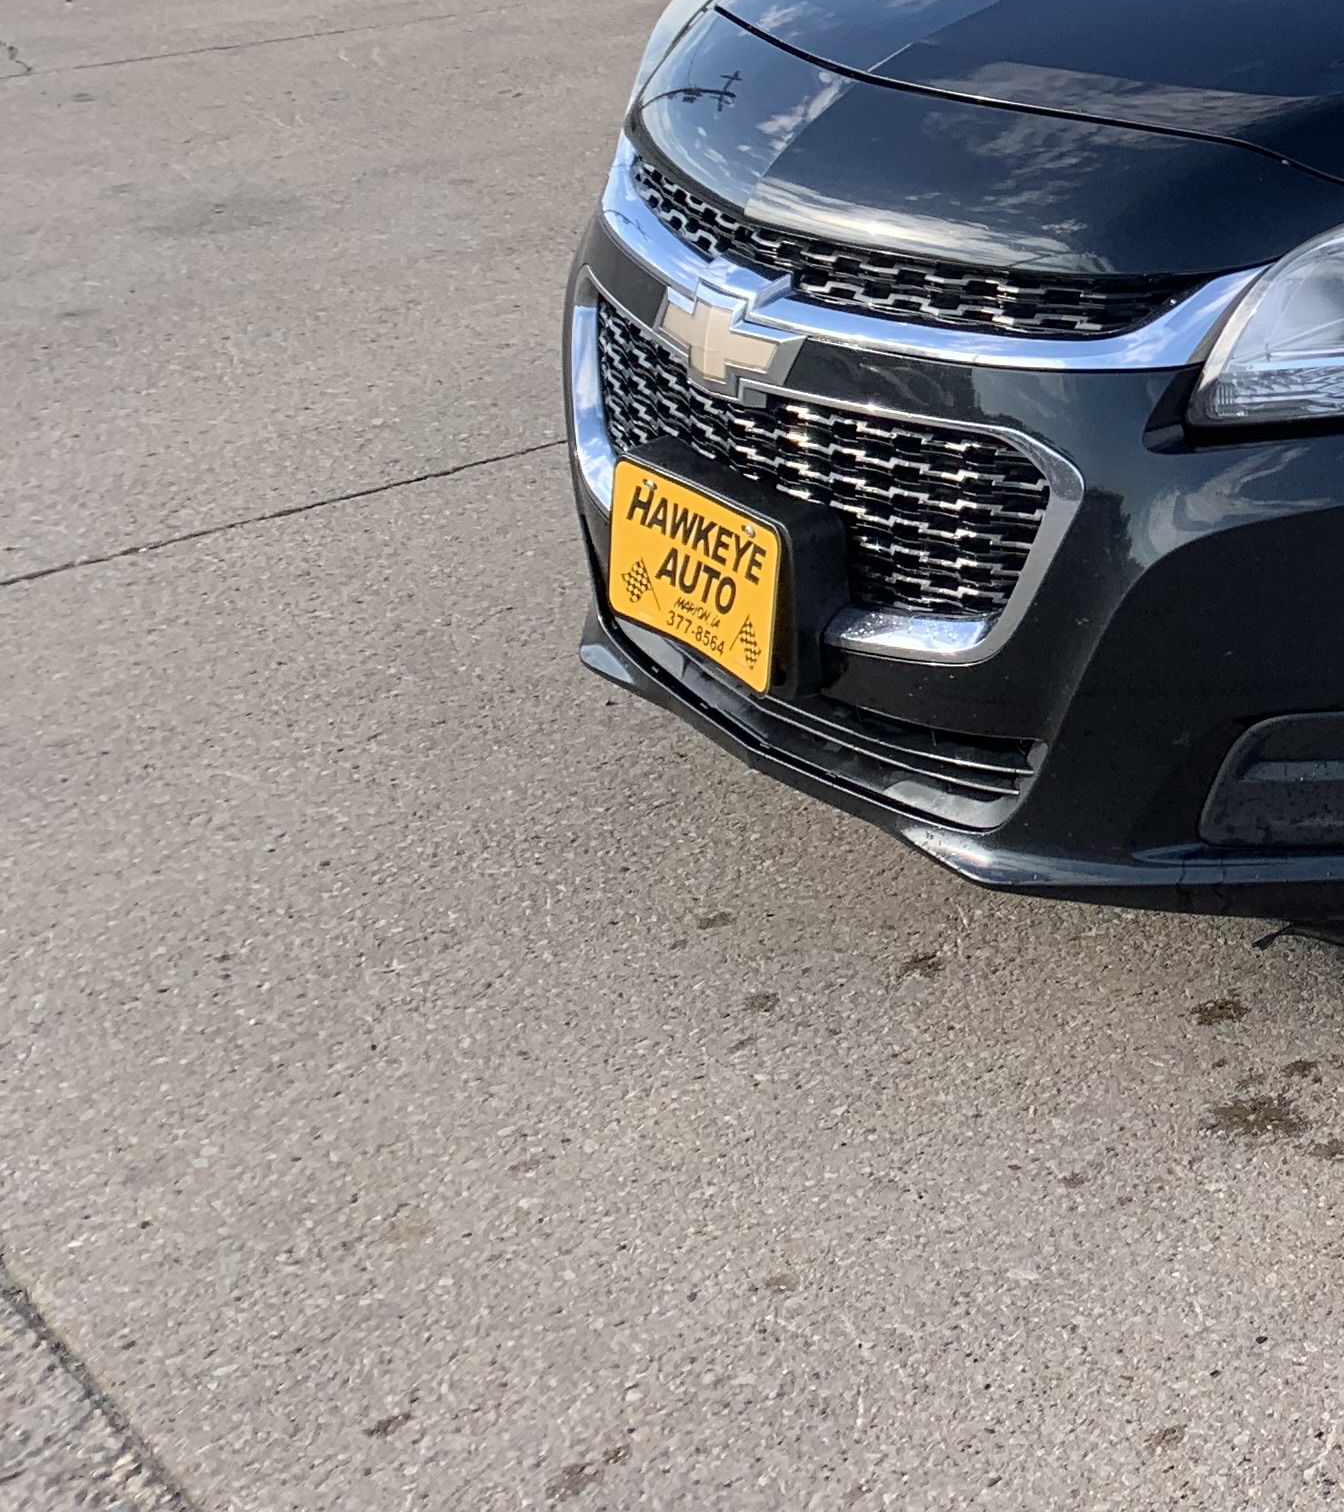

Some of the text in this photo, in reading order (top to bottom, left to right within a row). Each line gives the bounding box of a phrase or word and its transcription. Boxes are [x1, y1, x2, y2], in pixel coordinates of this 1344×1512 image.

[626, 486, 766, 585] HAWKEYE
[655, 548, 736, 614] AUTO
[665, 609, 724, 656] 377-8564
